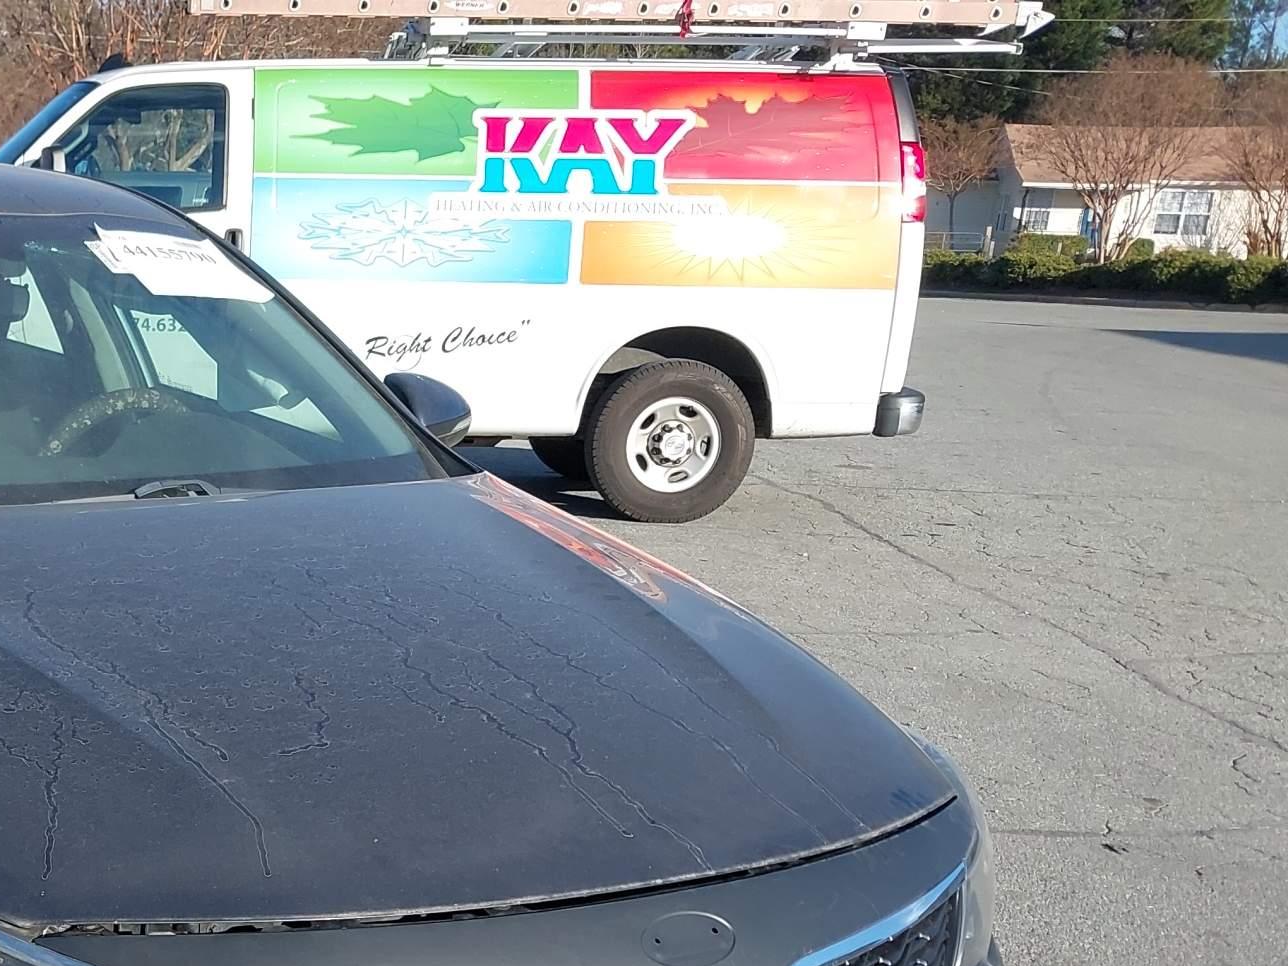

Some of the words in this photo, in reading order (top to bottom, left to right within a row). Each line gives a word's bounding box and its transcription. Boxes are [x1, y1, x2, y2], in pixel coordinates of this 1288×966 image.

[479, 116, 688, 195] KAY
[435, 199, 505, 213] HEATING
[511, 201, 521, 213] &
[364, 332, 433, 363] Right
